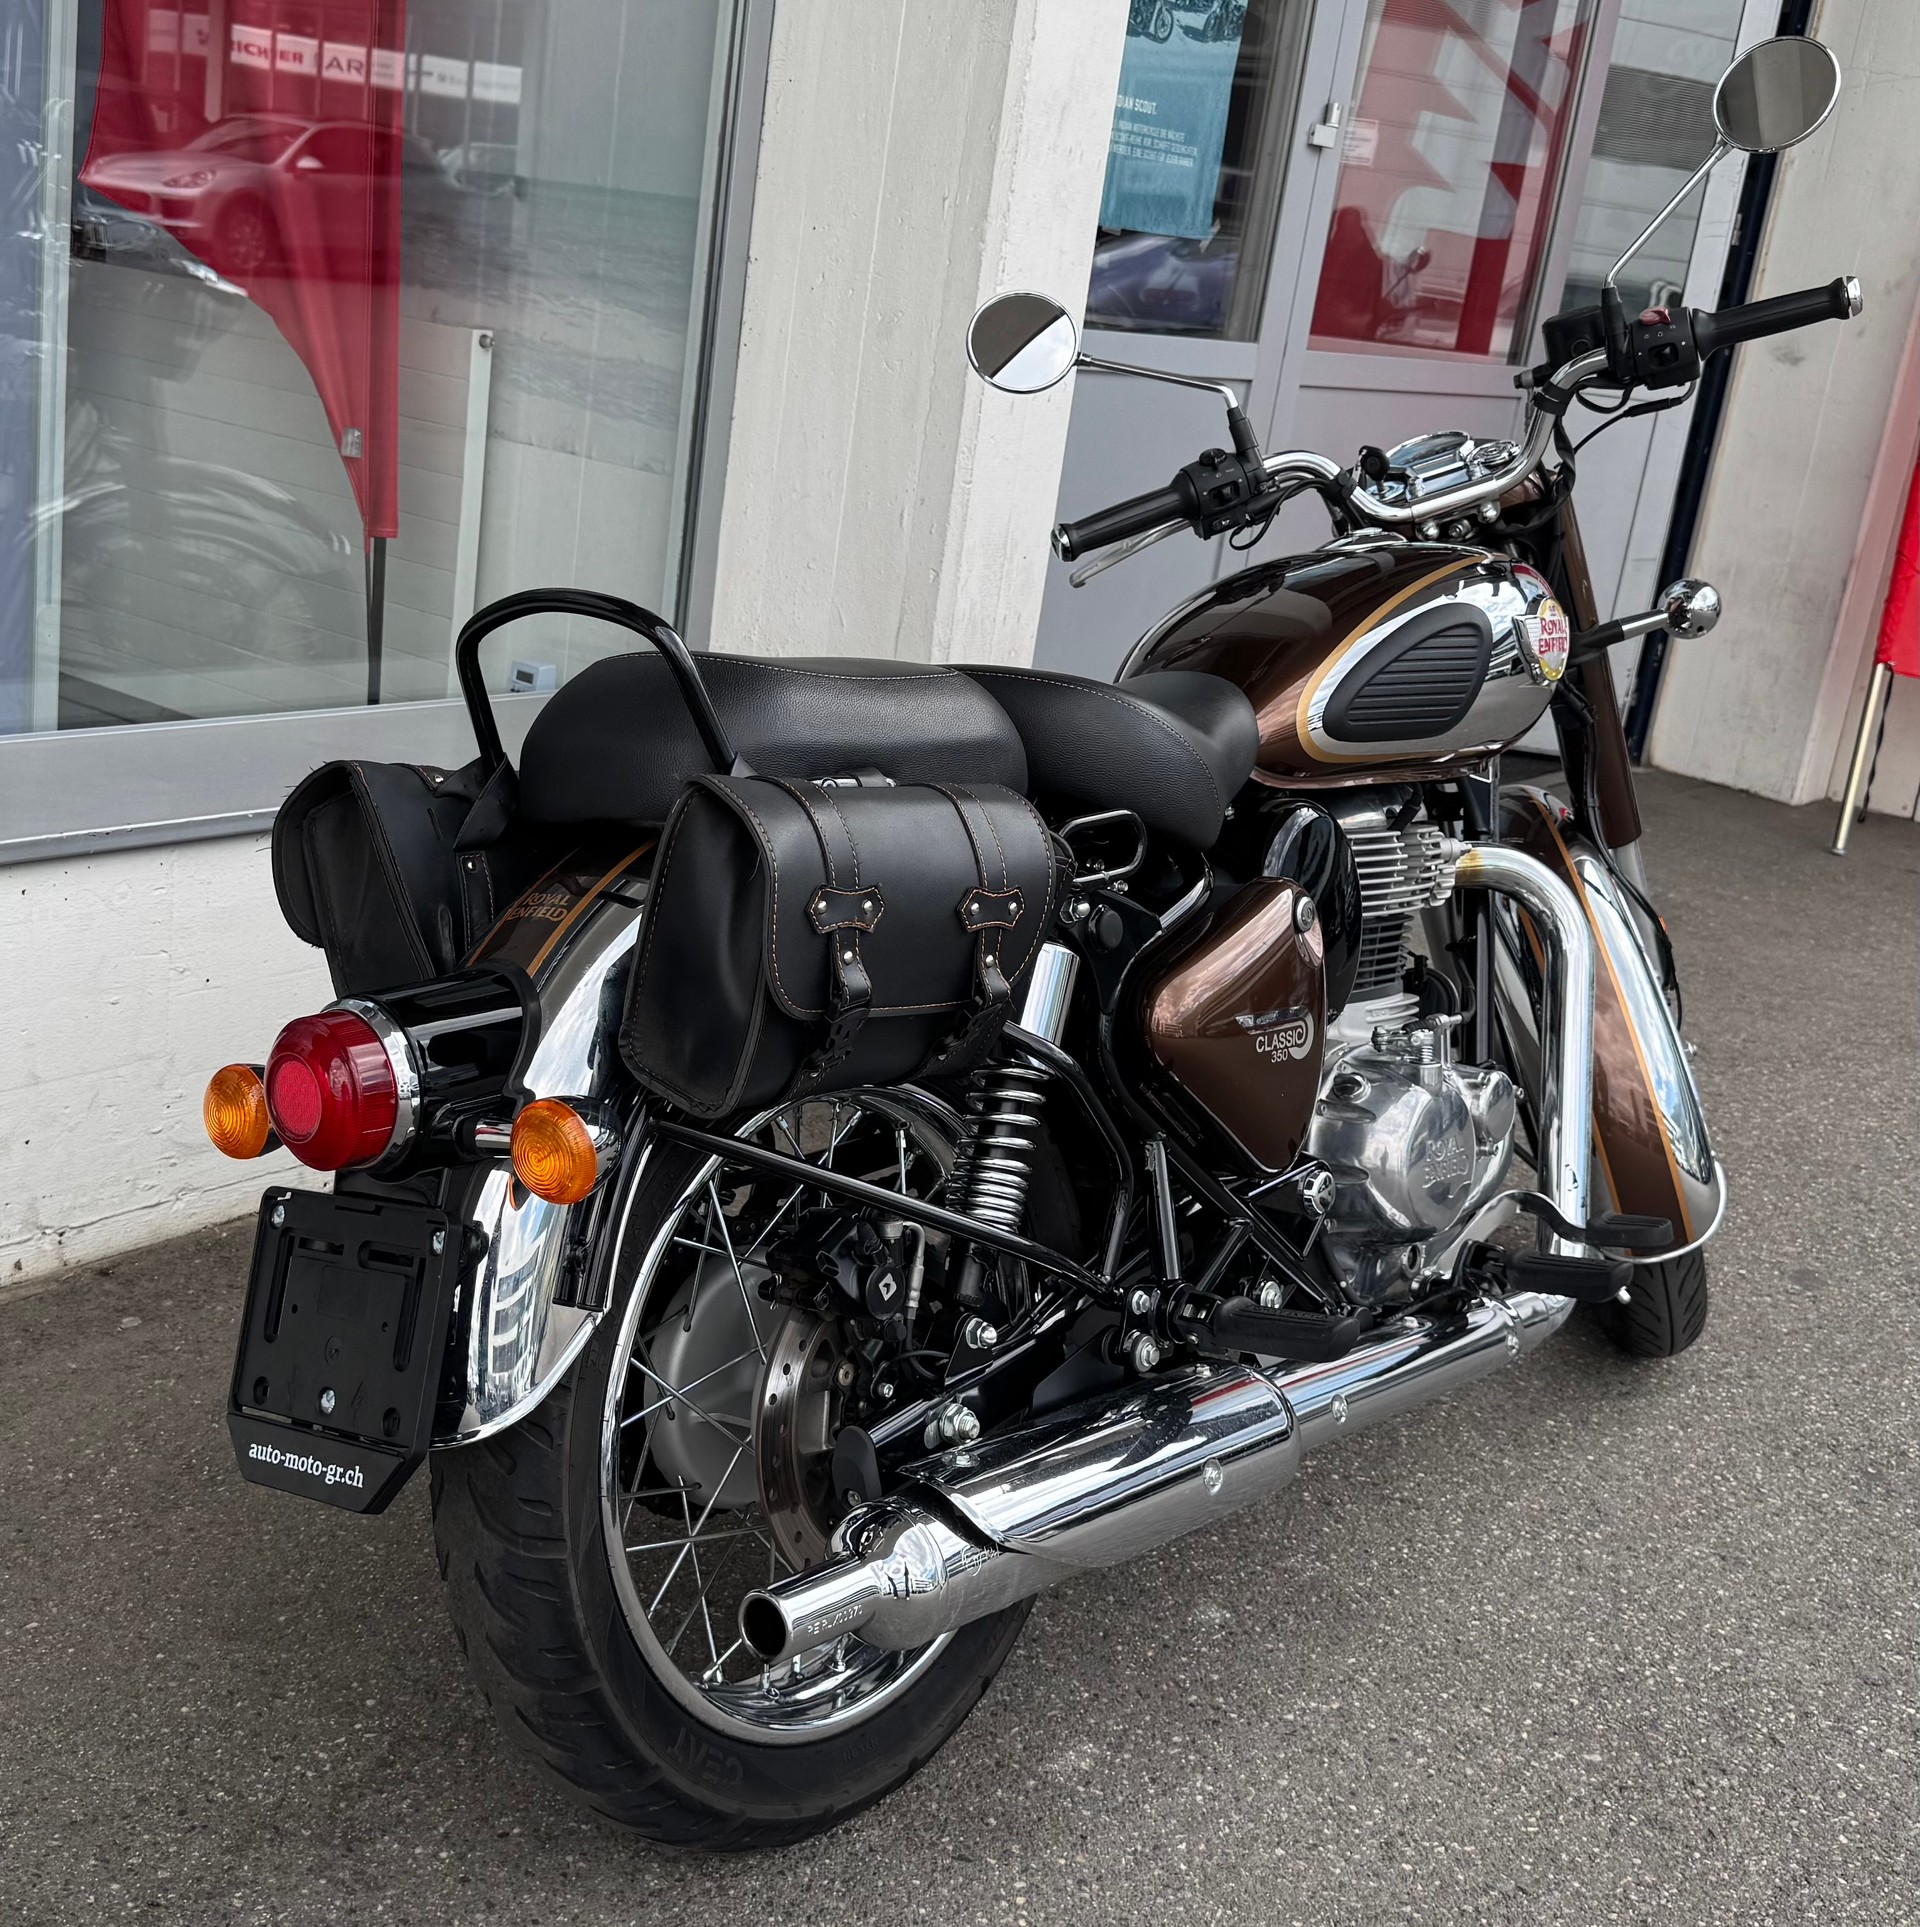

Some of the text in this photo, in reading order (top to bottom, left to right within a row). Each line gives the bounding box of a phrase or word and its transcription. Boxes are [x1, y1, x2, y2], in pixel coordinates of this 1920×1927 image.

[522, 892, 571, 906] ROYAL
[507, 905, 569, 922] ENFIELD
[1256, 1027, 1304, 1053] CLASSIC
[1271, 1048, 1289, 1063] 350
[1426, 1135, 1465, 1162] ROYAL
[248, 1442, 364, 1489] auto-moto-gr.ch
